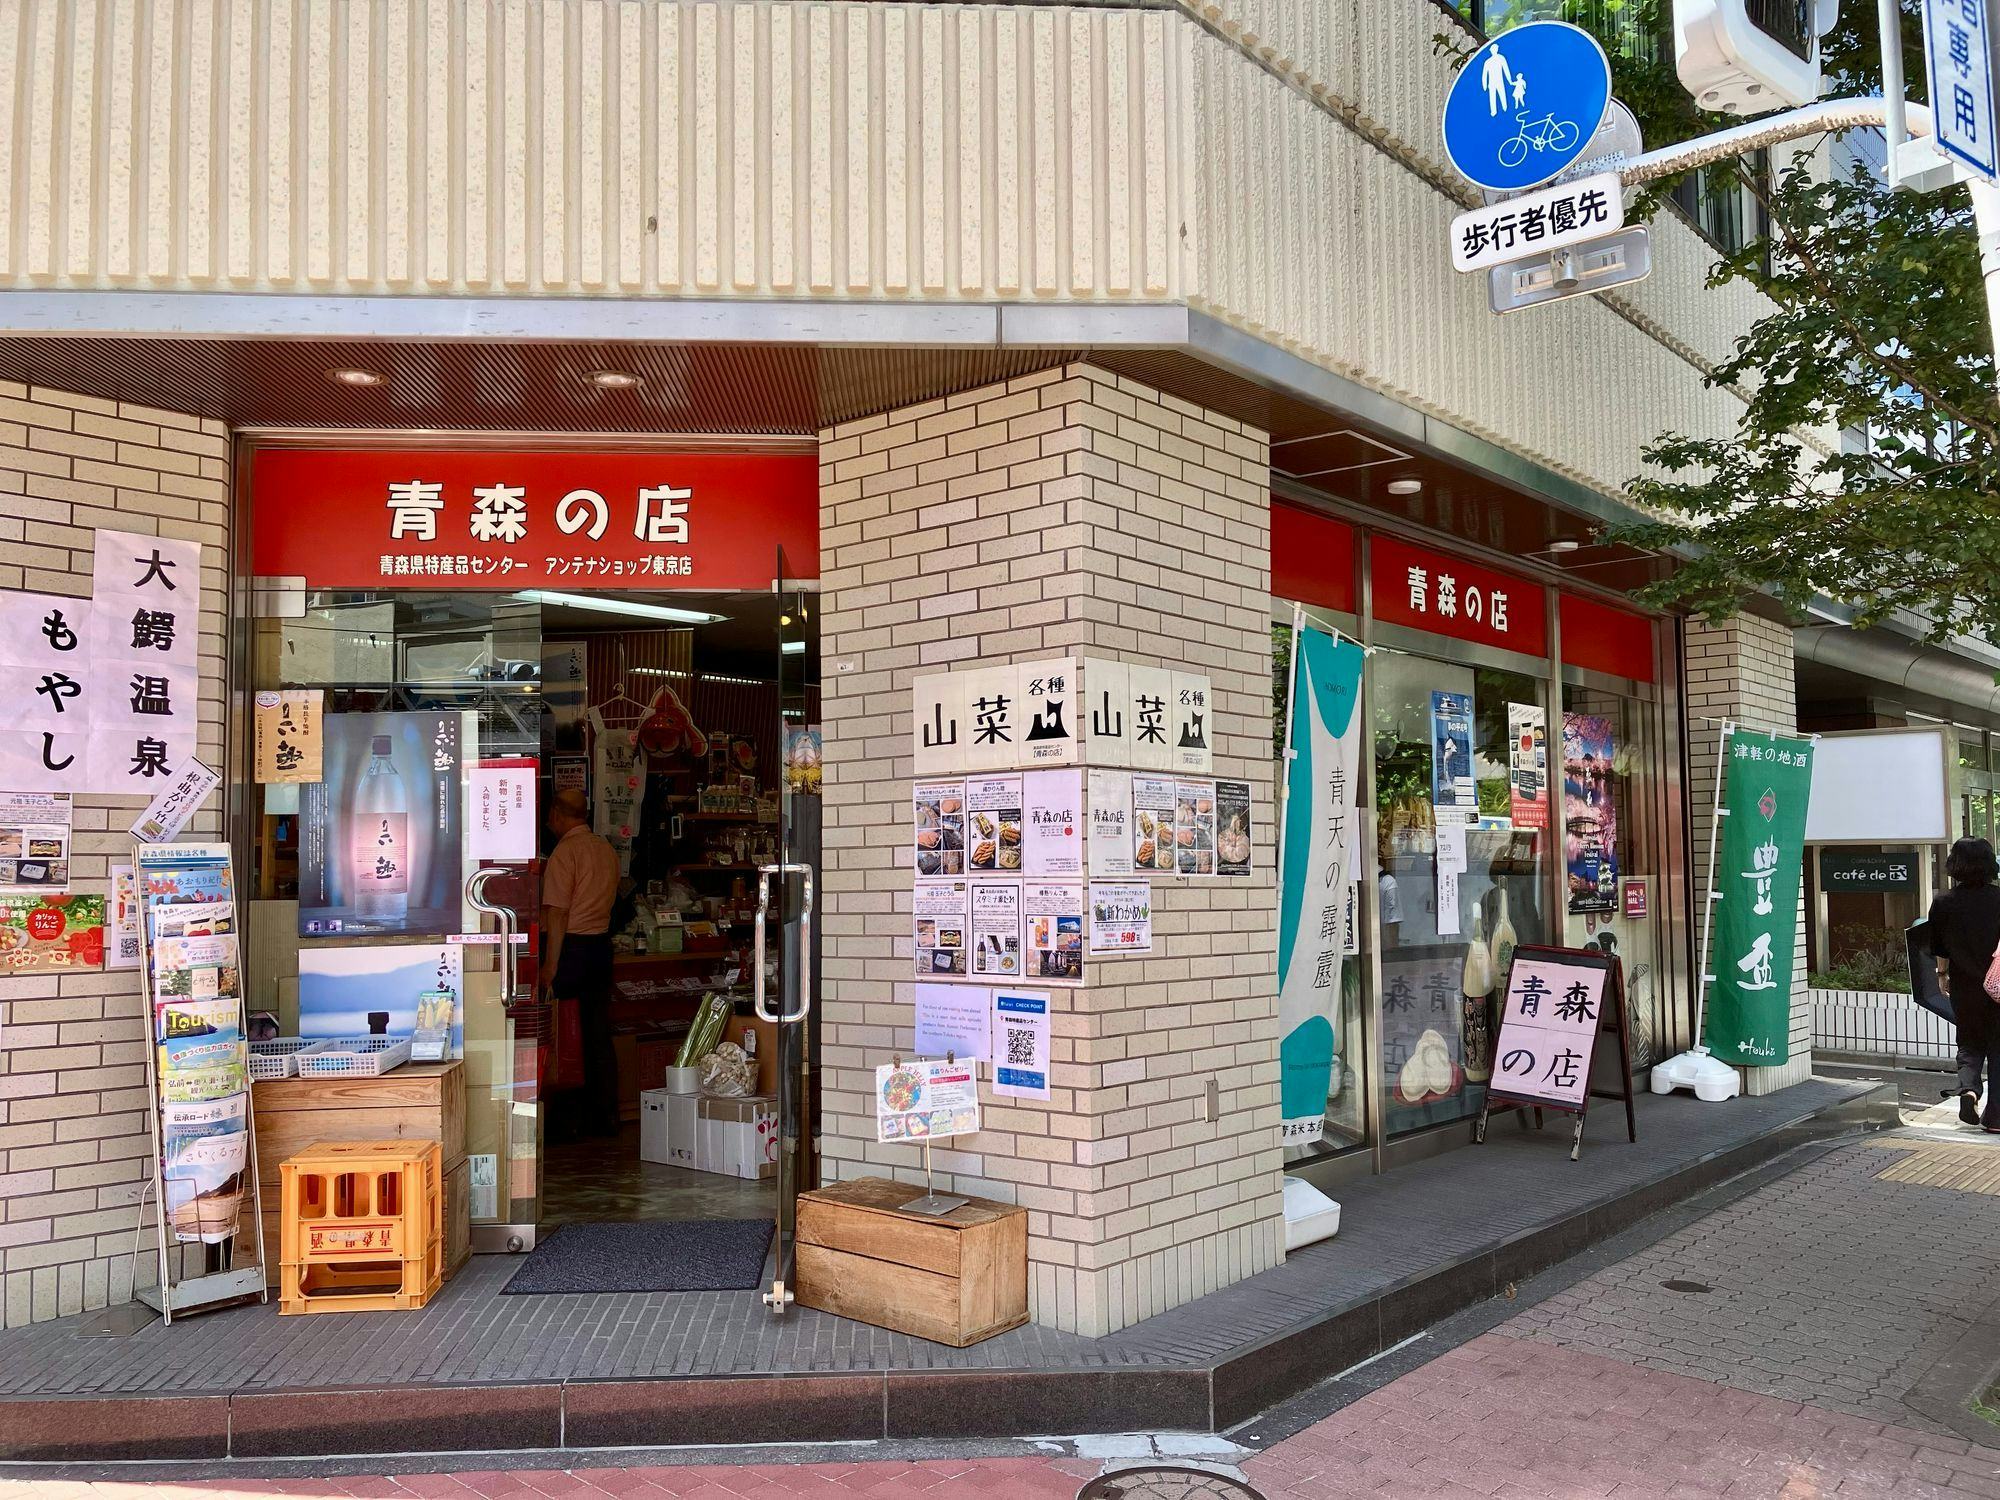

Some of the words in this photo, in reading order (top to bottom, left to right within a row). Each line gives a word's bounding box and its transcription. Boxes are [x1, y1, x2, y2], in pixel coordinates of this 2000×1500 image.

[1462, 189, 1608, 259] 歩行者優先
[385, 479, 693, 544] 青森の店
[379, 554, 528, 576] 青森県特産品センター
[545, 555, 692, 577] アンテナショップ東京店
[1407, 566, 1508, 632] 青森の店
[129, 549, 176, 777] 大鰐温泉
[35, 609, 82, 770] もやし
[1029, 675, 1065, 696] 各種
[1179, 689, 1205, 706] 各種
[923, 695, 1012, 748] 山菜
[1093, 690, 1166, 744] 山菜
[1733, 742, 1807, 767] 津軽の地酒
[155, 771, 201, 823] 根曲がり竹
[498, 779, 508, 796] 新物
[499, 799, 508, 825] ごぼう
[1031, 809, 1073, 824] 青森の店
[1093, 808, 1125, 823] 青森の店
[1312, 766, 1346, 989] 青天の霹靂
[1833, 869, 1866, 881] café
[1870, 869, 1886, 881] de
[35, 921, 58, 929] りんご
[1107, 905, 1141, 920] 新わかめ
[1121, 932, 1136, 942] 598
[1512, 975, 1597, 1024] 青森
[169, 1010, 237, 1029] Tourism
[1502, 1047, 1583, 1088] の店
[174, 1113, 209, 1121] 伝承ロード
